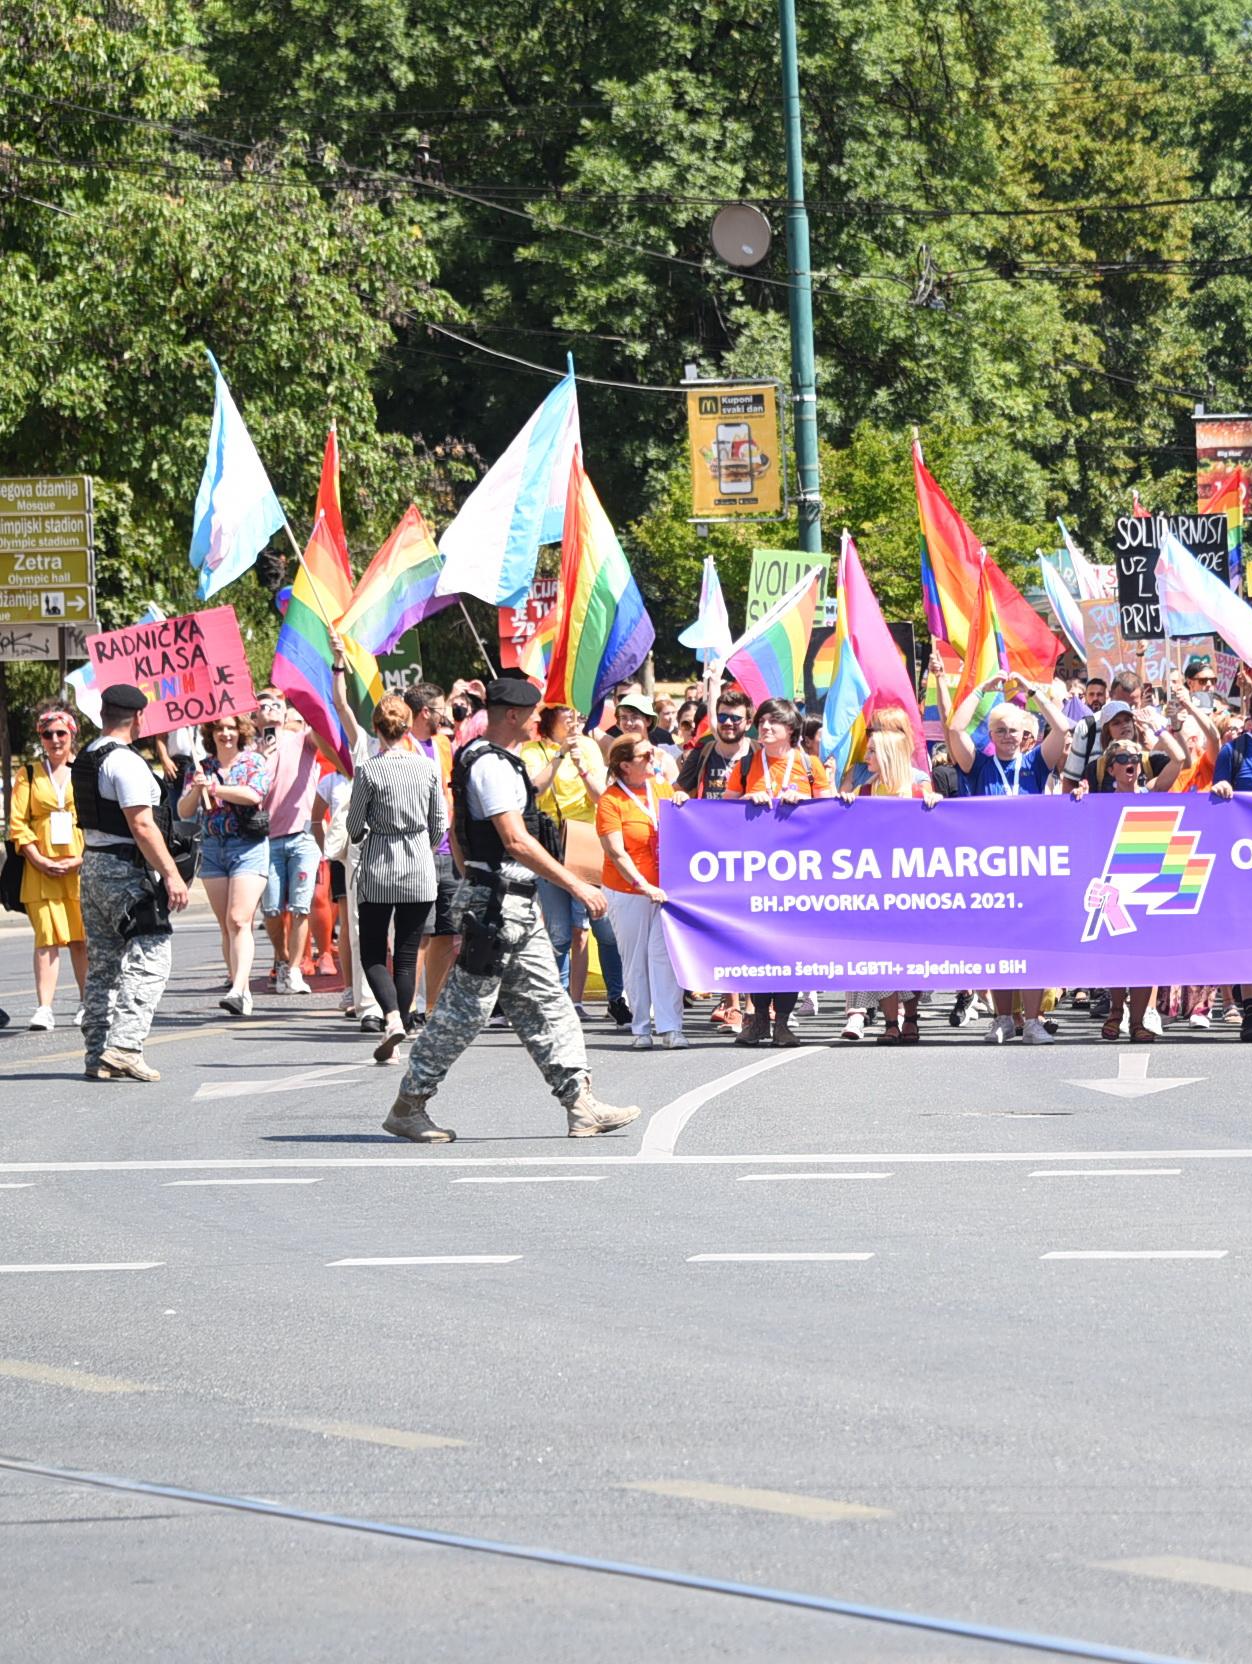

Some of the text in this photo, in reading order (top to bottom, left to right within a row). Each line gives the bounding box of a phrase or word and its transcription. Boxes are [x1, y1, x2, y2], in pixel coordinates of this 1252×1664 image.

[722, 396, 753, 405] Kuponi
[722, 404, 764, 414] svaki dan
[0, 480, 78, 501] egova džamija
[17, 501, 55, 511] Mosque
[0, 517, 84, 537] impijski stadion
[1117, 515, 1226, 549] SOLIDARNOST
[40, 537, 79, 547] stadium
[14, 554, 62, 570] Zetra
[1121, 556, 1147, 575] UZ
[8, 572, 70, 585] Olympic hall
[95, 619, 205, 663] RADNIČKA
[135, 644, 208, 680] KLASA
[214, 665, 234, 686] JE
[166, 689, 235, 721] BOJA
[689, 845, 1071, 883] OTPOR SA MARGINE
[750, 892, 1024, 912] BH.POVORKA PONOSA 2021.
[713, 959, 1026, 980] protestna šetnja LGBTI+ zajednice u BiH
